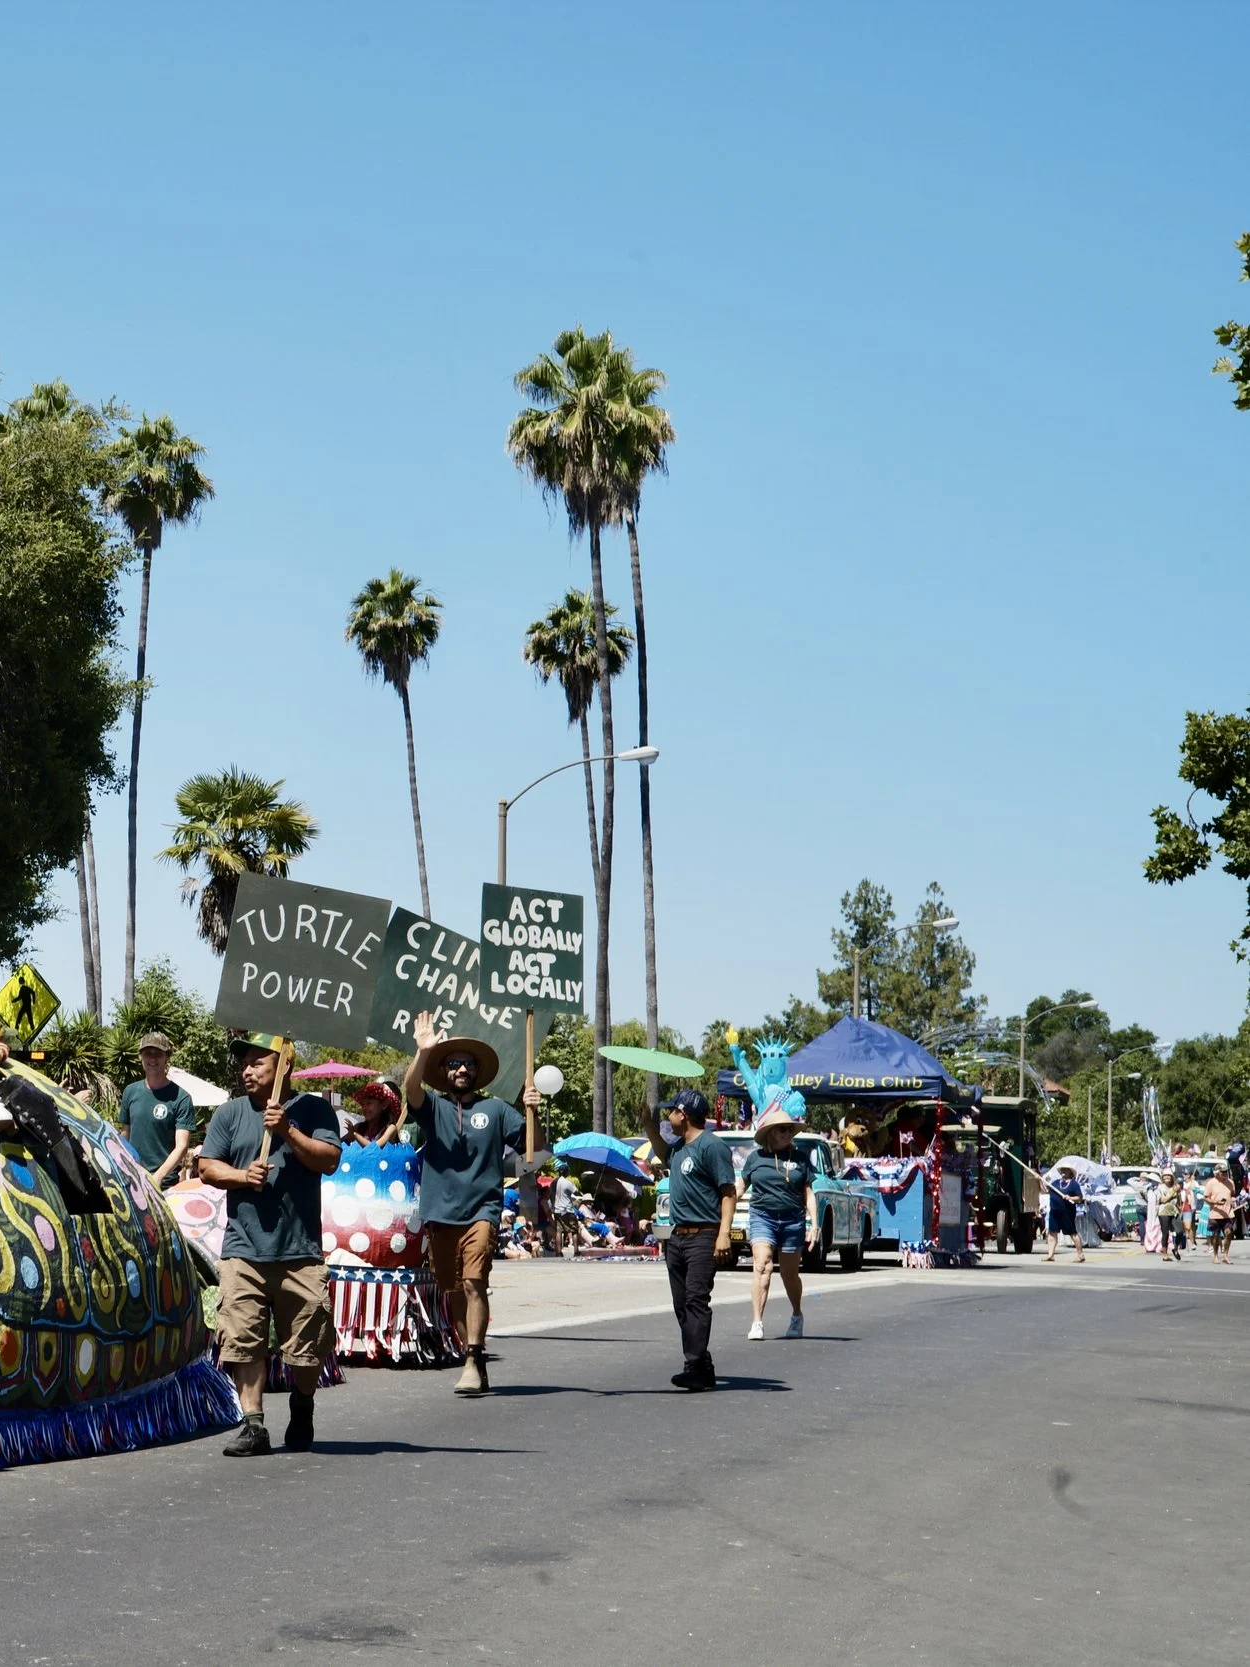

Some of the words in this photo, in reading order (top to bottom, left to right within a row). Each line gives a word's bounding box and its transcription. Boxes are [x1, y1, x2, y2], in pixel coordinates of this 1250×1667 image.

[509, 896, 564, 923] ACT
[236, 903, 381, 970] TURTLE
[483, 919, 583, 956] GLOBALLY
[508, 950, 557, 977] ACT
[242, 962, 354, 1016] POWER
[491, 972, 583, 1003] LOCALLY
[829, 1073, 875, 1088] Lions
[881, 1076, 923, 1089] Club
